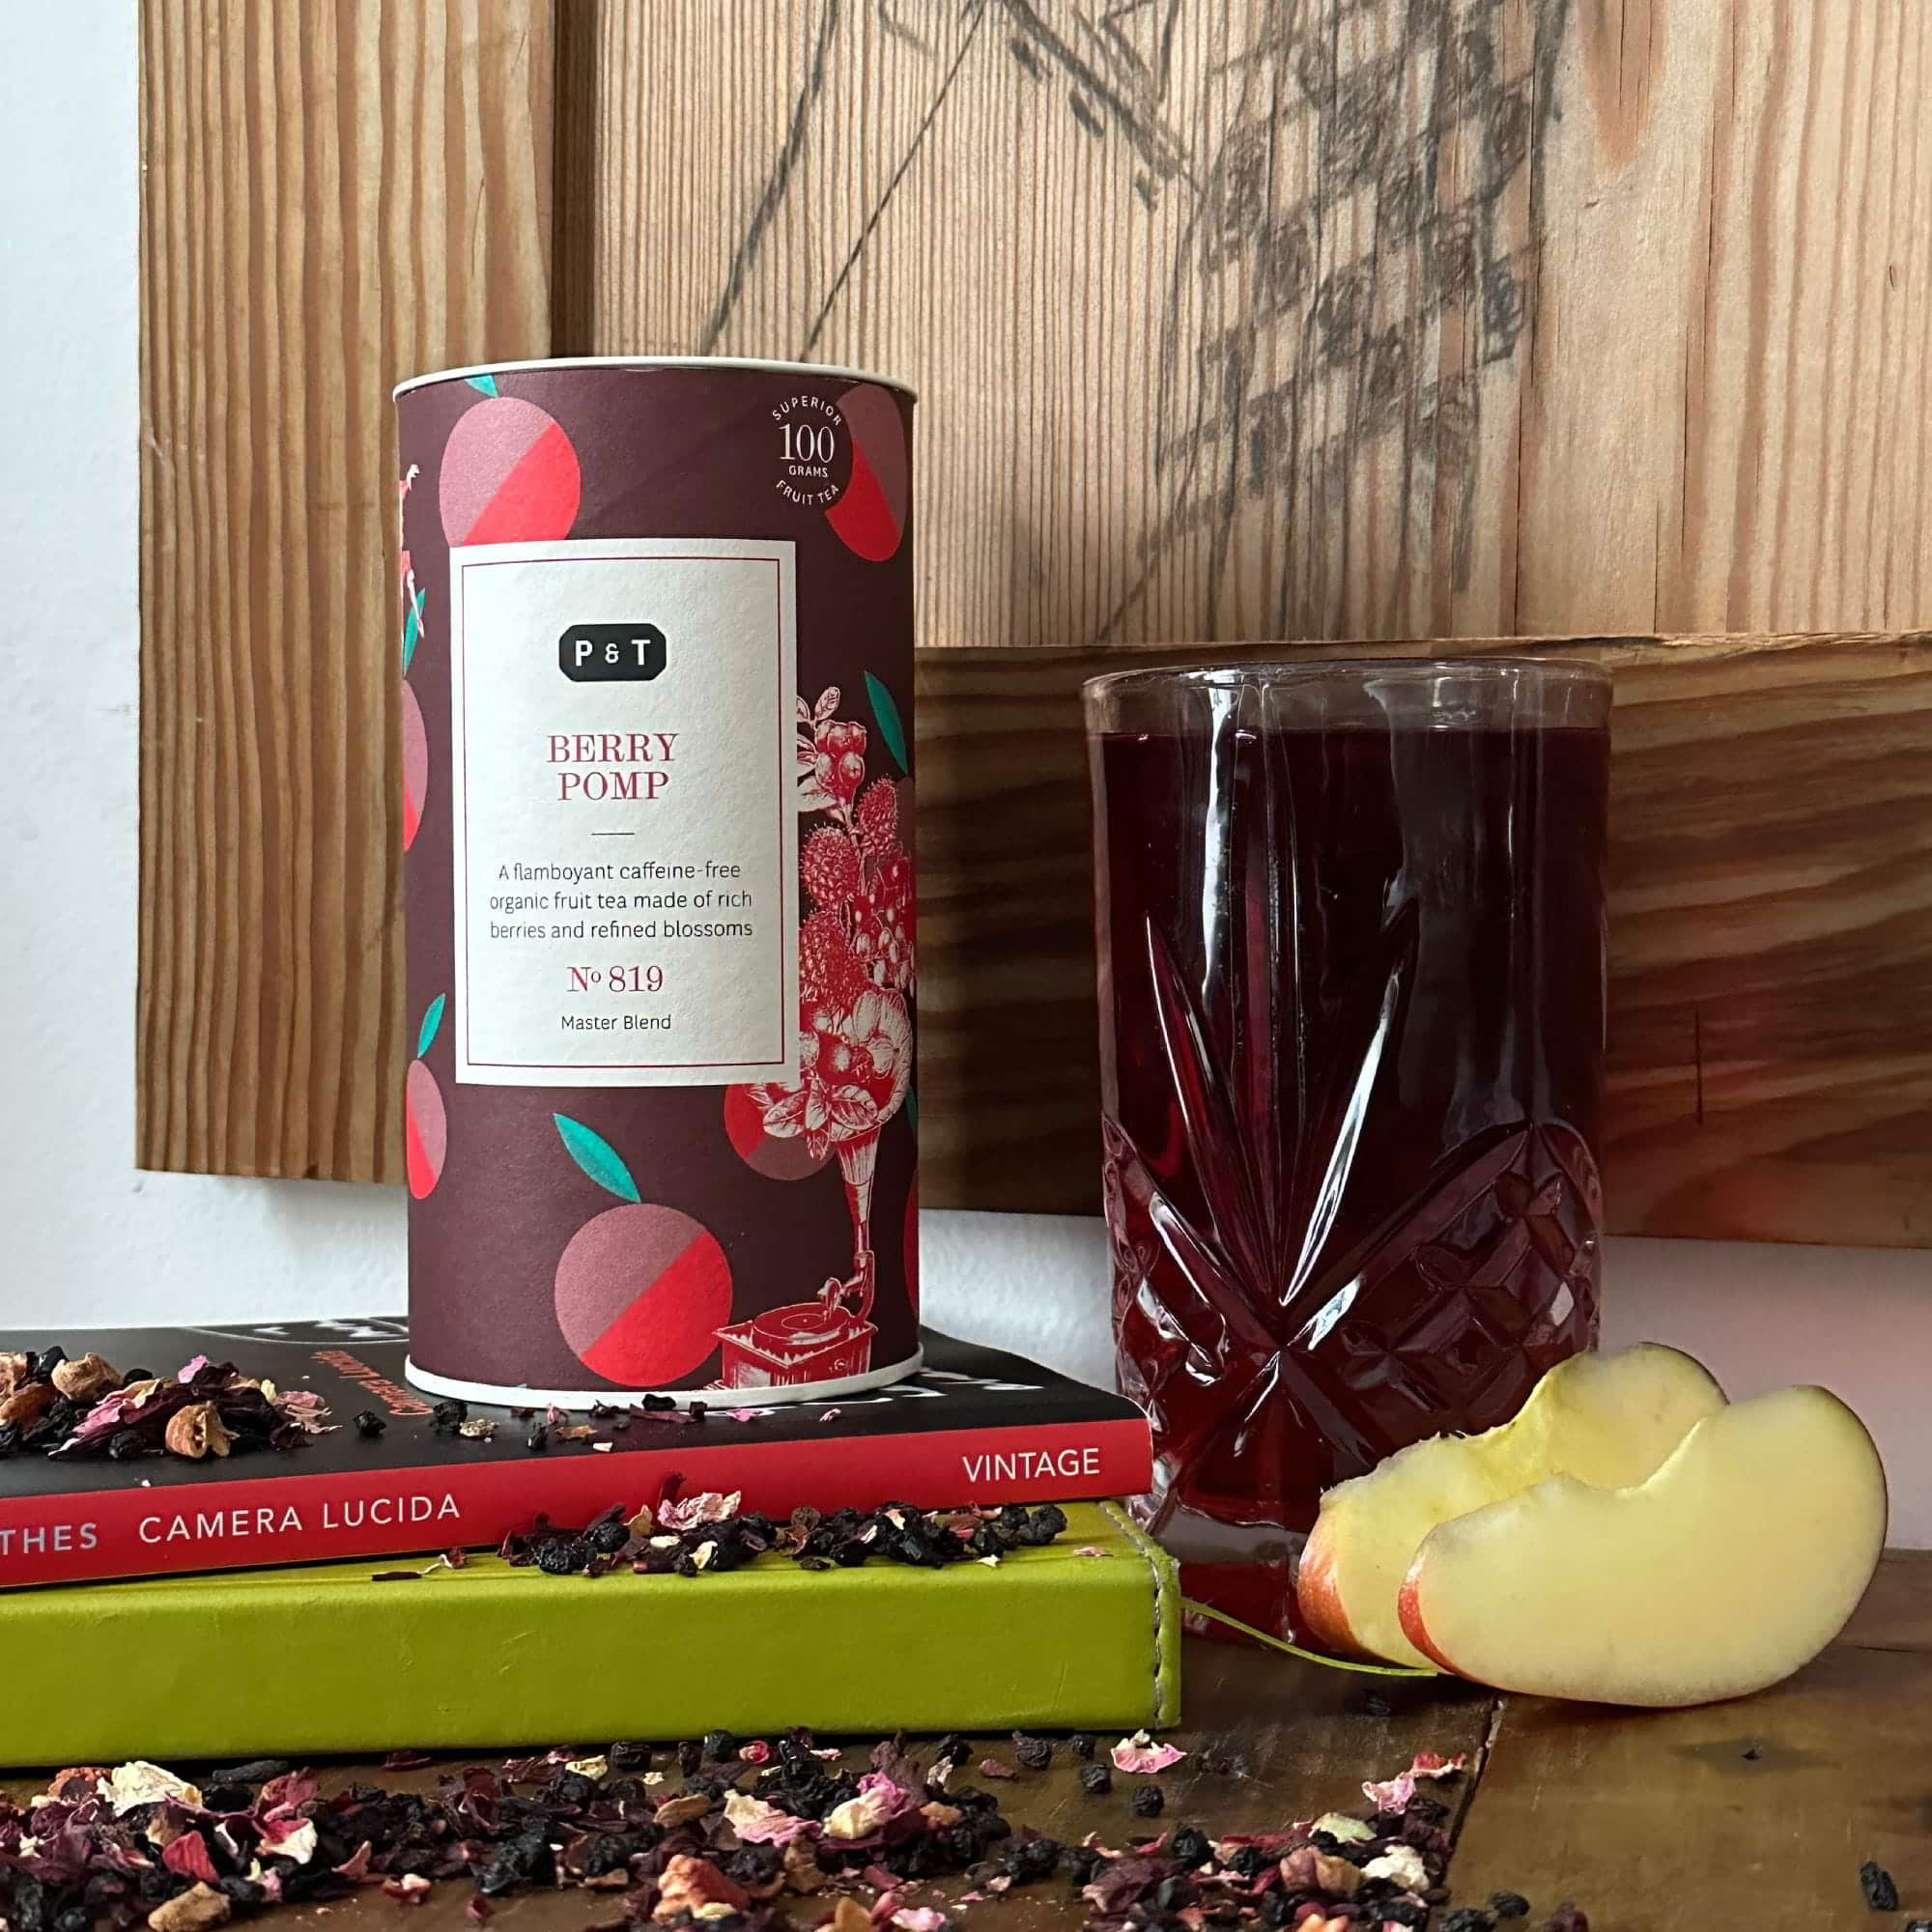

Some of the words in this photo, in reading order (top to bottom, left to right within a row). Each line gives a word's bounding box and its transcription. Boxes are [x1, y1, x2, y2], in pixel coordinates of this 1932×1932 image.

[772, 395, 842, 426] SUPERIOR
[779, 423, 835, 464] 100
[788, 465, 829, 478] GRAMS
[776, 479, 813, 505] FRUIT
[817, 484, 839, 503] TEA
[575, 639, 594, 667] P
[605, 643, 620, 664] &
[631, 639, 651, 666] T
[546, 732, 680, 763] BERRY
[557, 771, 669, 801] POMP
[498, 864, 510, 881] A
[514, 862, 614, 886] flamboyant
[619, 860, 741, 880] caffeine-free
[490, 892, 550, 915] organic
[554, 891, 594, 910] fruit
[597, 893, 627, 910] tea
[634, 891, 688, 909] made
[693, 889, 714, 908] of
[718, 889, 753, 908] rich
[490, 920, 547, 939] berries
[550, 920, 584, 939] and
[590, 919, 657, 939] refined
[664, 919, 753, 938] blossoms
[608, 965, 664, 993] 819
[561, 1014, 618, 1031] Master
[623, 1012, 672, 1031] Blend
[962, 1447, 1101, 1483] VINTAGE
[139, 1506, 303, 1544] CAMERA
[322, 1492, 461, 1529] LUCIDA
